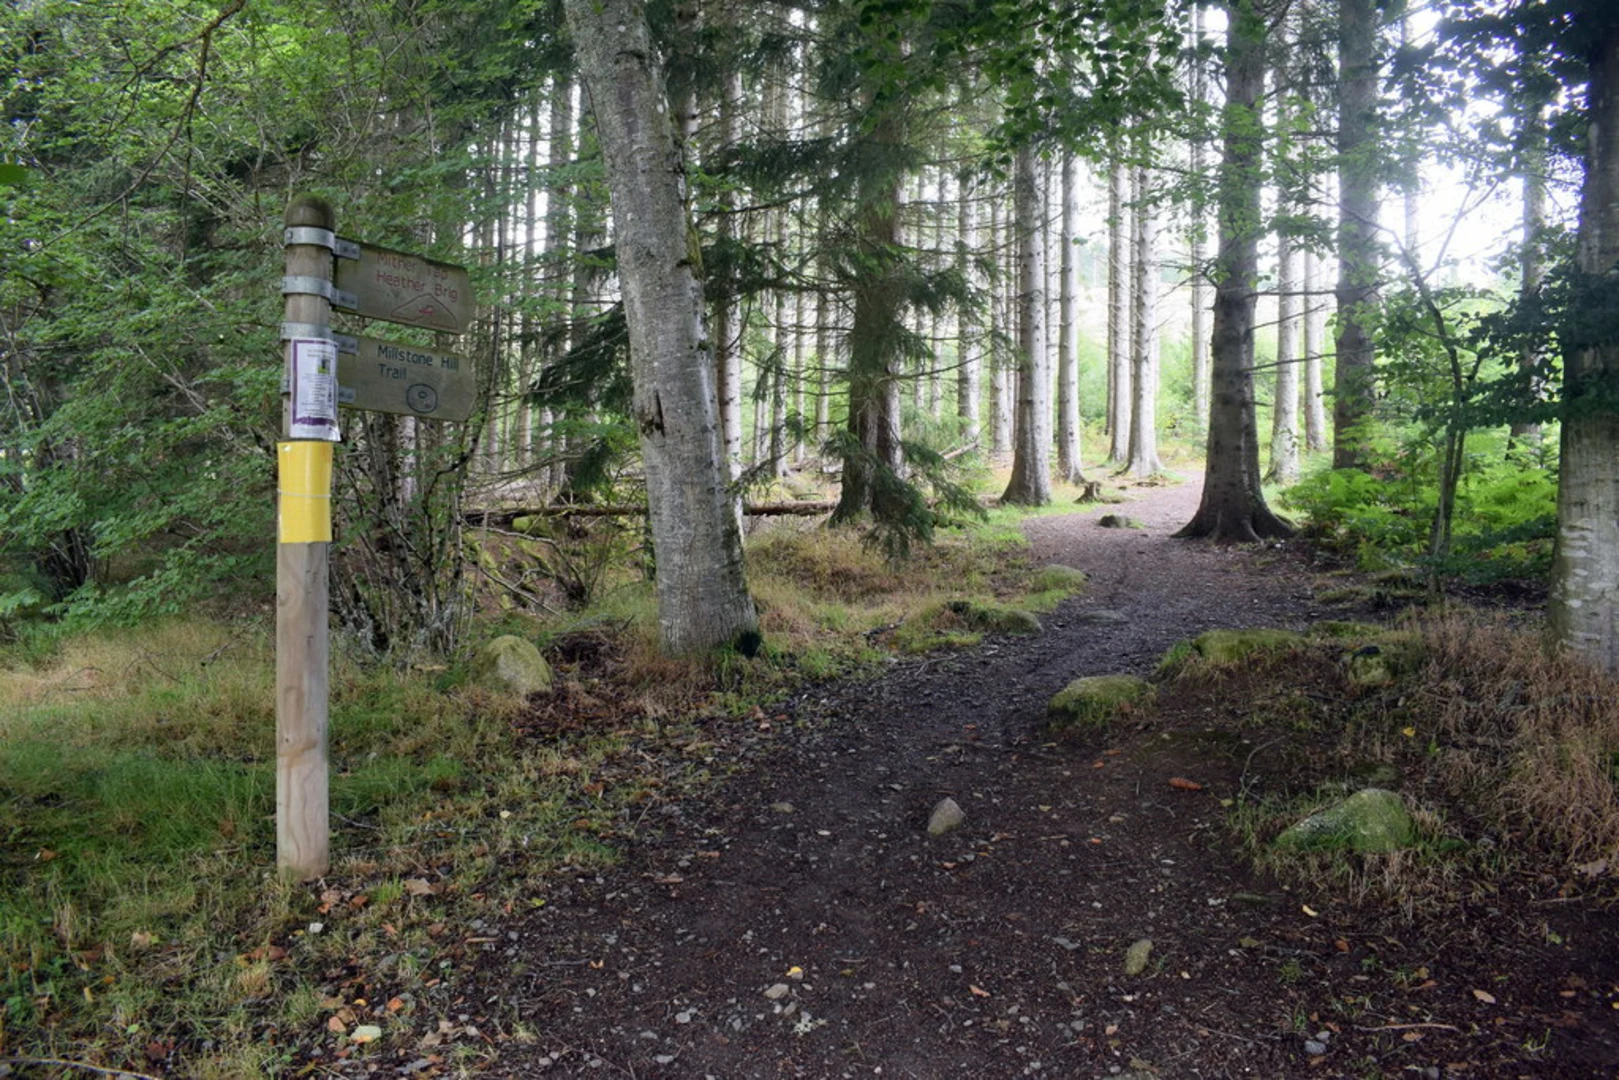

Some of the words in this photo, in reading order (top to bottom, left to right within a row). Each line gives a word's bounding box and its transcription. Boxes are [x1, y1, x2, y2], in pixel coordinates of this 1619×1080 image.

[377, 252, 416, 272] Mither
[426, 265, 448, 282] Tap
[377, 270, 425, 292] Heather
[435, 283, 458, 303] Brig
[377, 344, 433, 366] Millstone
[441, 356, 459, 370] Hill
[379, 363, 407, 379] Trail
